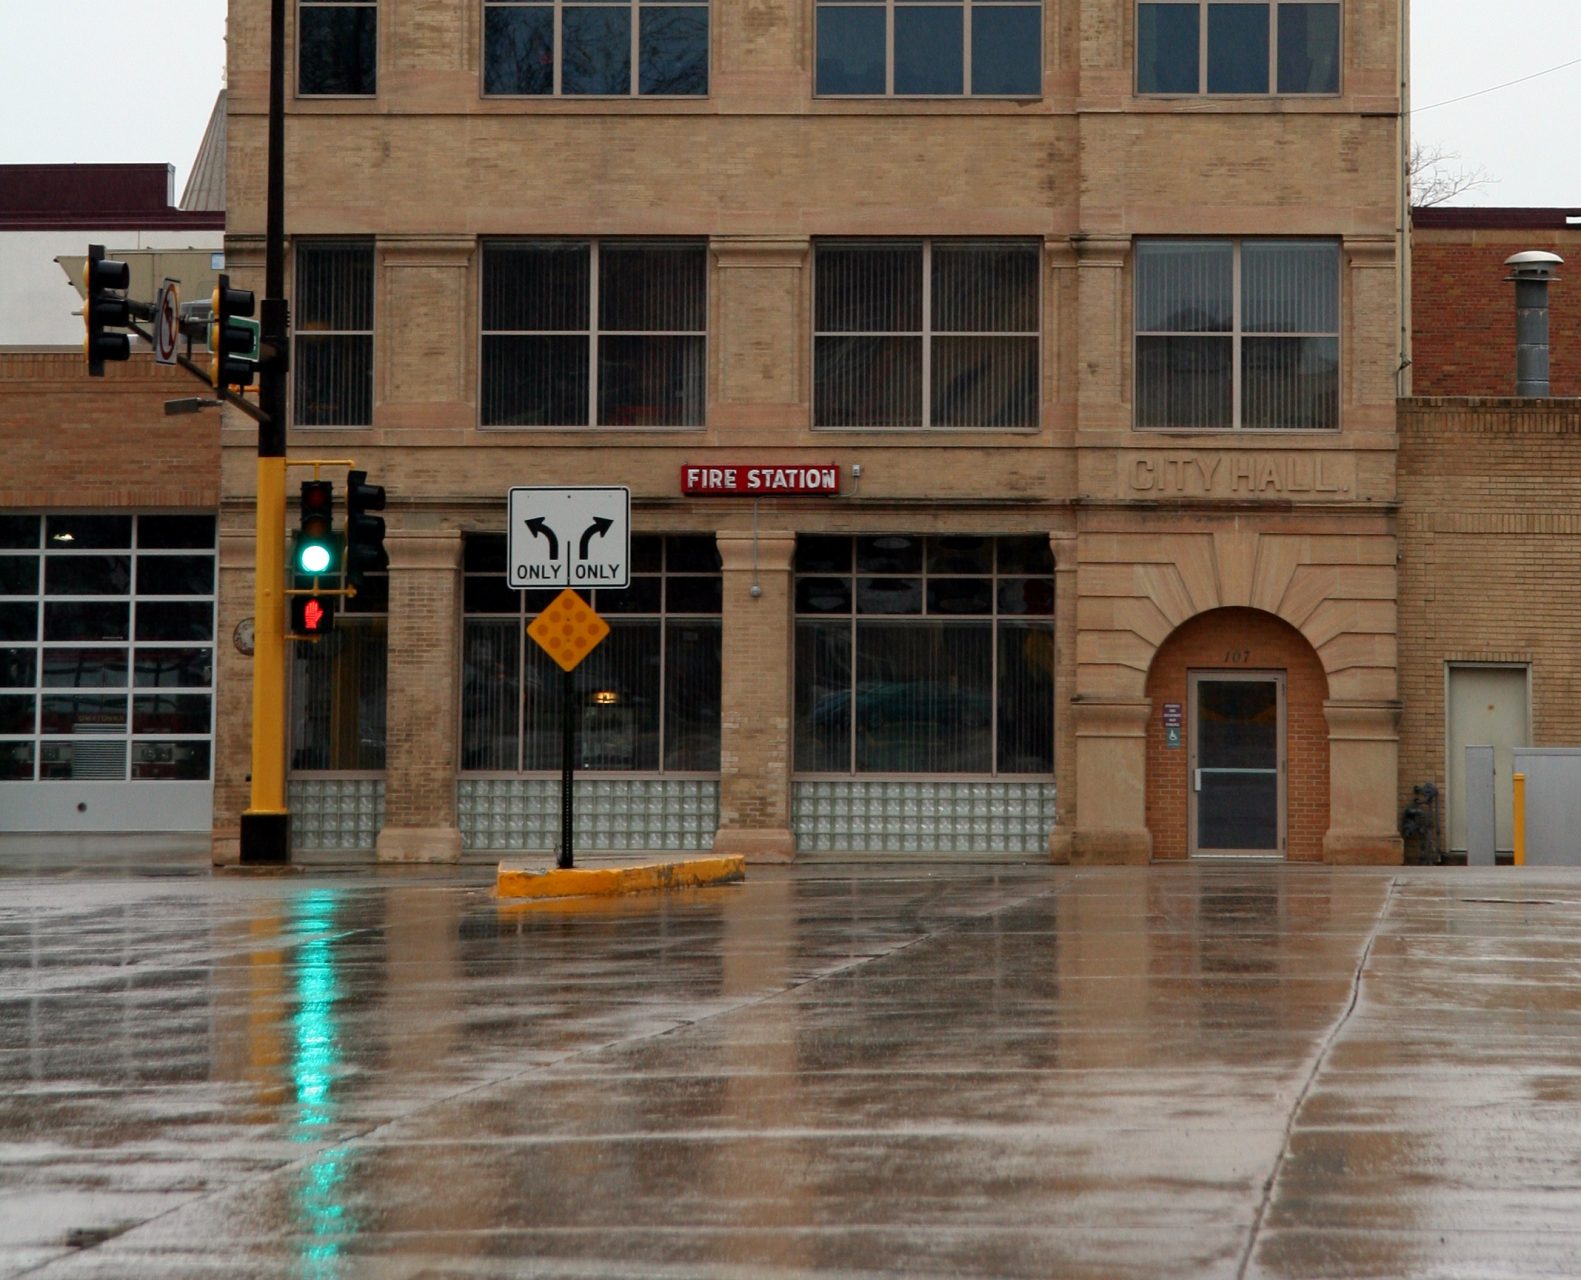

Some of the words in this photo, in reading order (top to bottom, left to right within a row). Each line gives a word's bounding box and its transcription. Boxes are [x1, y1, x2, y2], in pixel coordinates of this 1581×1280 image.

[687, 469, 737, 489] FIRE
[747, 469, 836, 489] STATION
[1130, 458, 1221, 492] CITY
[517, 564, 561, 580] ONLY
[575, 564, 620, 580] ONLY
